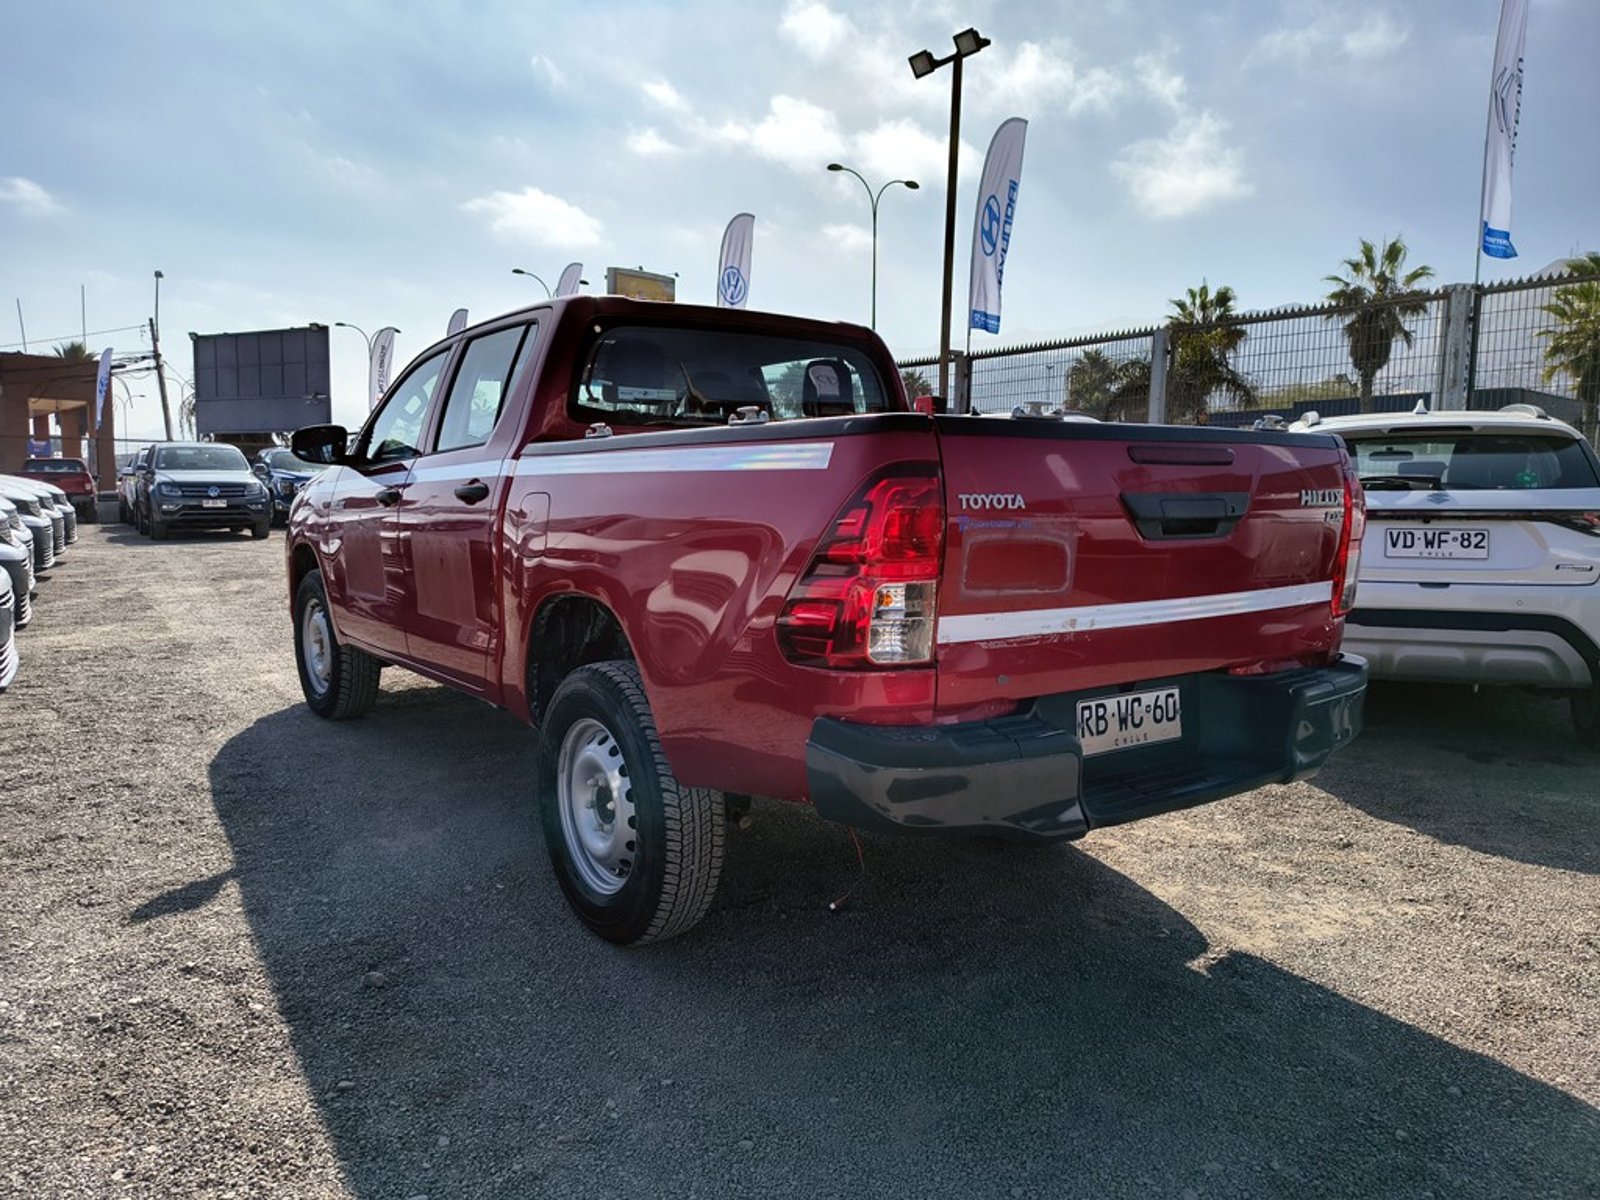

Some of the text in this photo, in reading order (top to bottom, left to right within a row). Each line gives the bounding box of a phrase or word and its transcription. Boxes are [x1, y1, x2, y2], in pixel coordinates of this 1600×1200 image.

[958, 494, 1026, 509] TOYOTA
[1301, 489, 1344, 506] HILUX
[1114, 732, 1149, 747] CHILE
